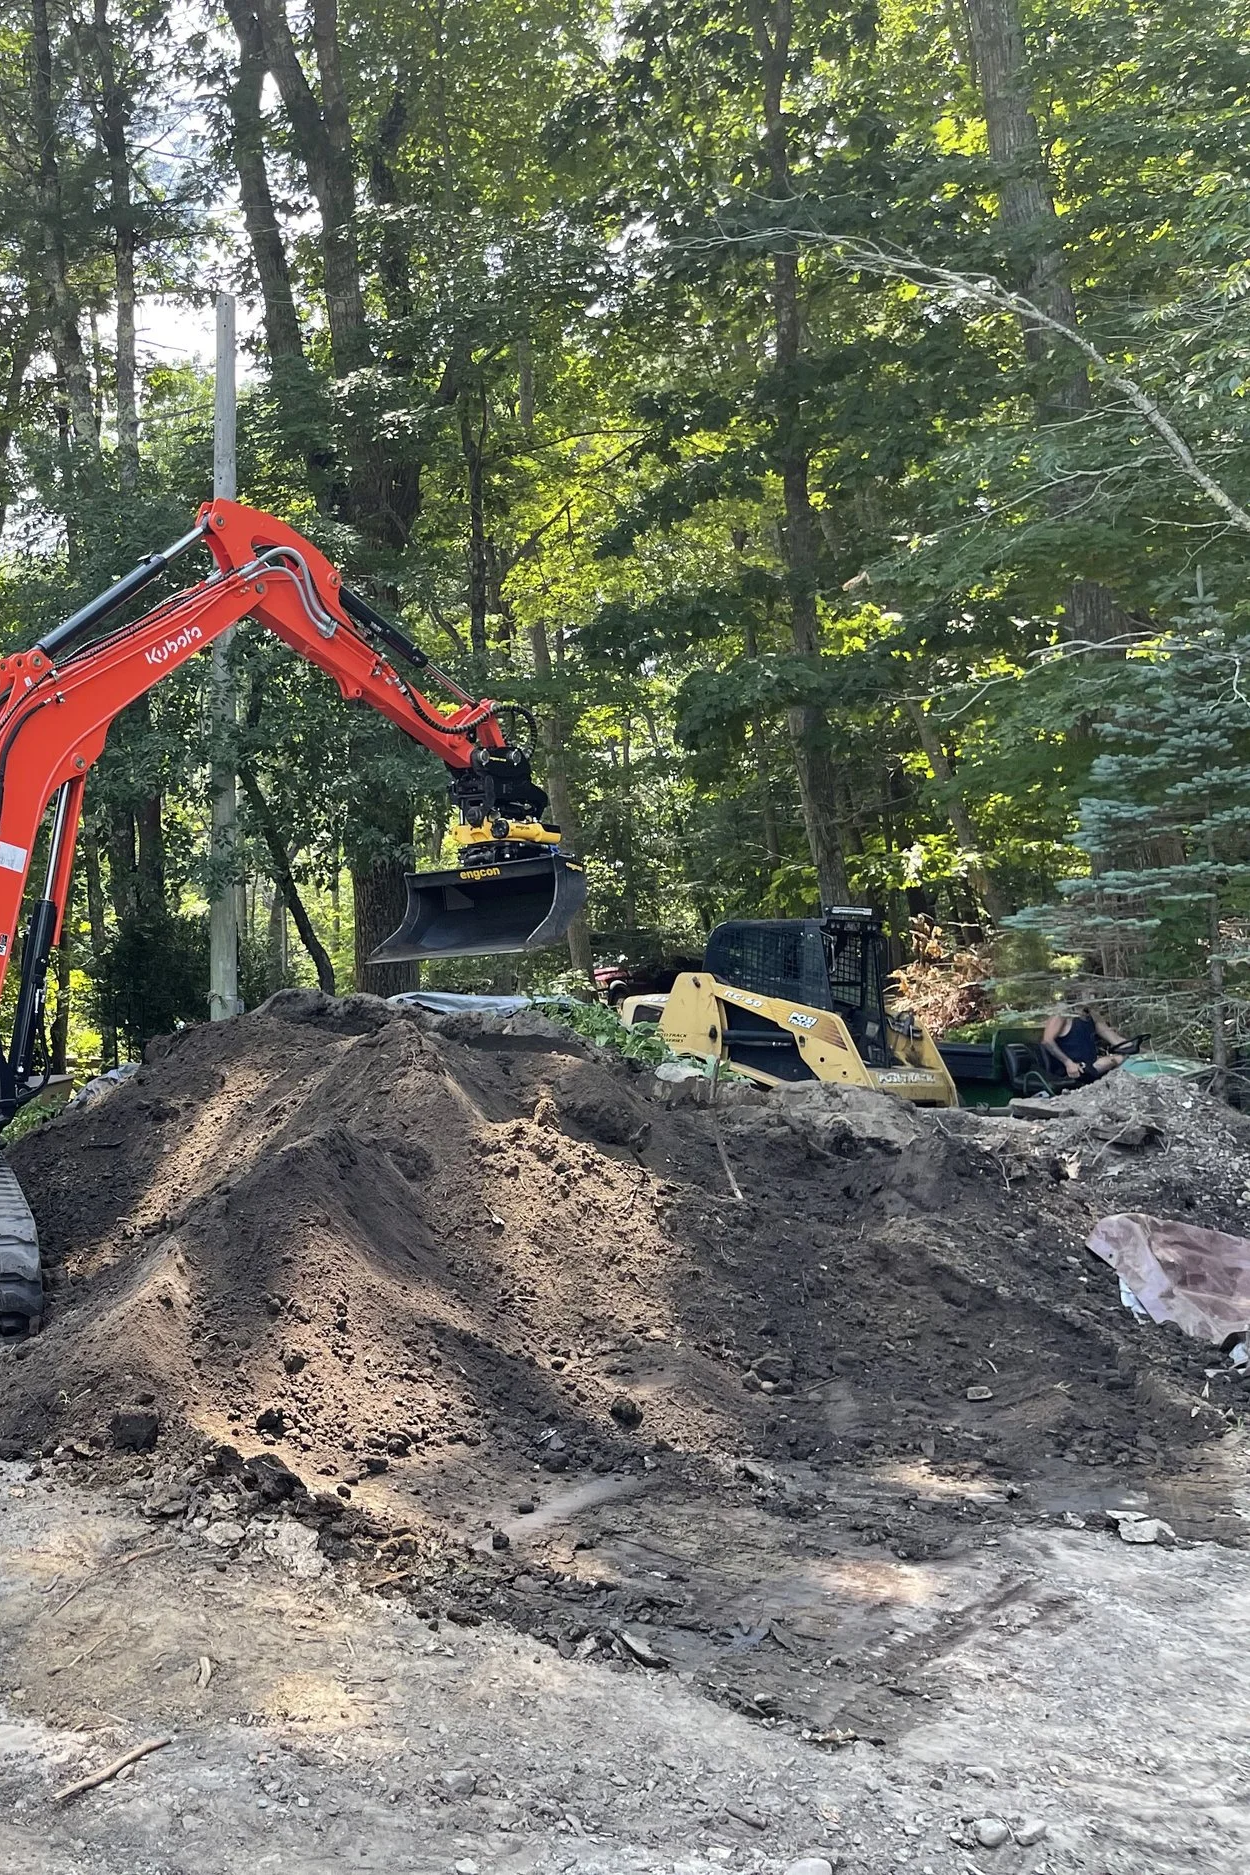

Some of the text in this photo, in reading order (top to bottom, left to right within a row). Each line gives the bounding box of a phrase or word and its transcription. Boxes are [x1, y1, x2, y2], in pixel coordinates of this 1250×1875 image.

[145, 625, 203, 665] Kubota
[459, 867, 501, 881] engcon
[789, 1011, 818, 1026] POSI
